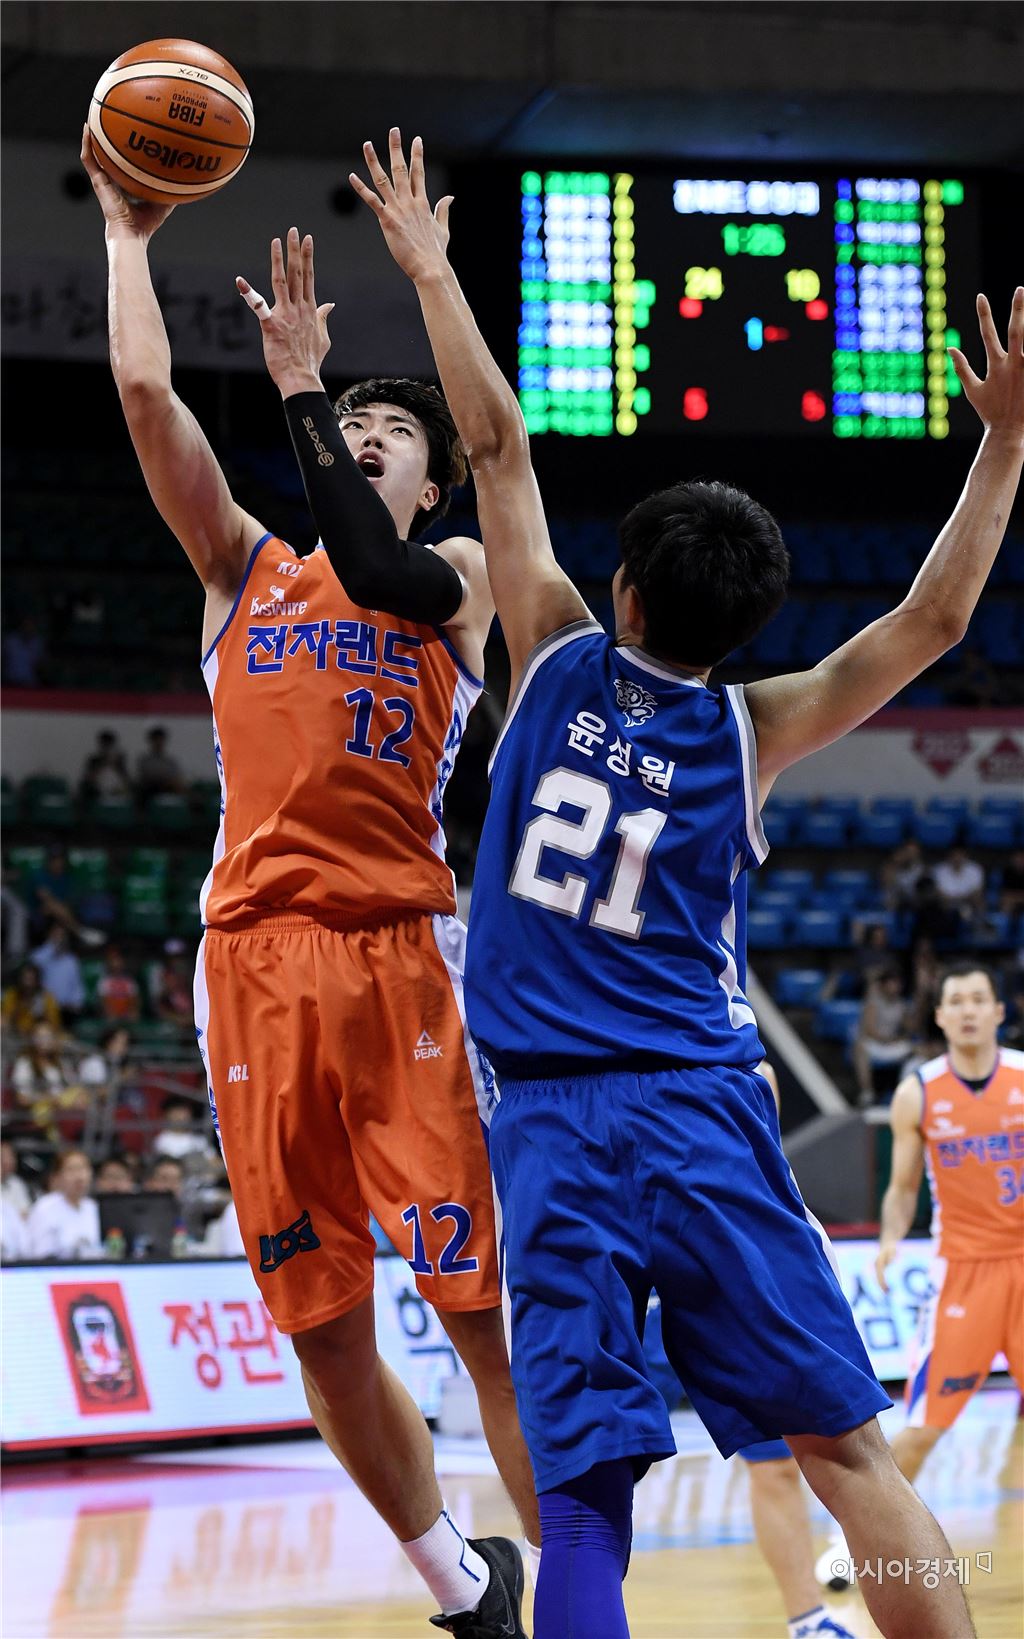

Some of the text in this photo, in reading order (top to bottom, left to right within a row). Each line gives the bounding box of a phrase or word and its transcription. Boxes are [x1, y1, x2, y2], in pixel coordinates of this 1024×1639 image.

[168, 102, 205, 128] FIBA
[172, 93, 208, 109] APPROVED
[128, 131, 222, 172] molten
[245, 619, 423, 688] 전자랜드
[344, 687, 416, 769] 12
[567, 710, 676, 798] 윤성원
[508, 765, 668, 940] 21
[413, 1044, 443, 1060] PEAK
[401, 1202, 480, 1277] 12
[163, 1300, 286, 1389] 정관
